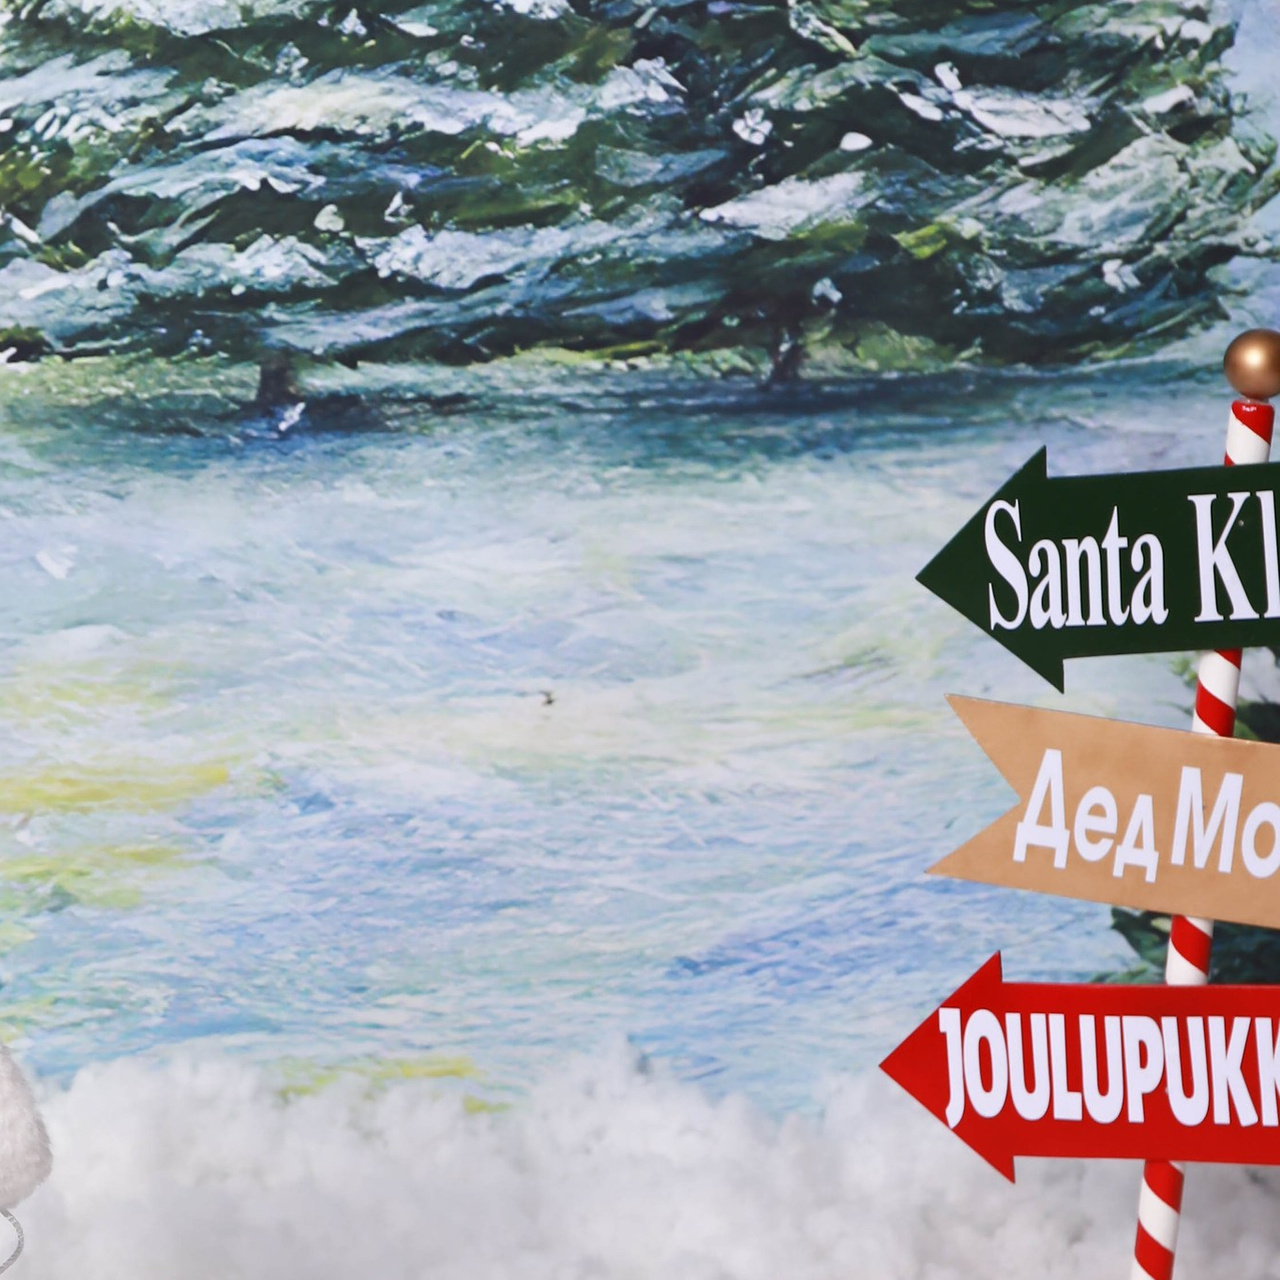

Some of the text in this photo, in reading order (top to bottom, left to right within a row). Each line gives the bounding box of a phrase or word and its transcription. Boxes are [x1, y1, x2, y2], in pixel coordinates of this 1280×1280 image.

[984, 490, 1280, 631] Santa Kl
[1012, 748, 1280, 883] Дед Мо
